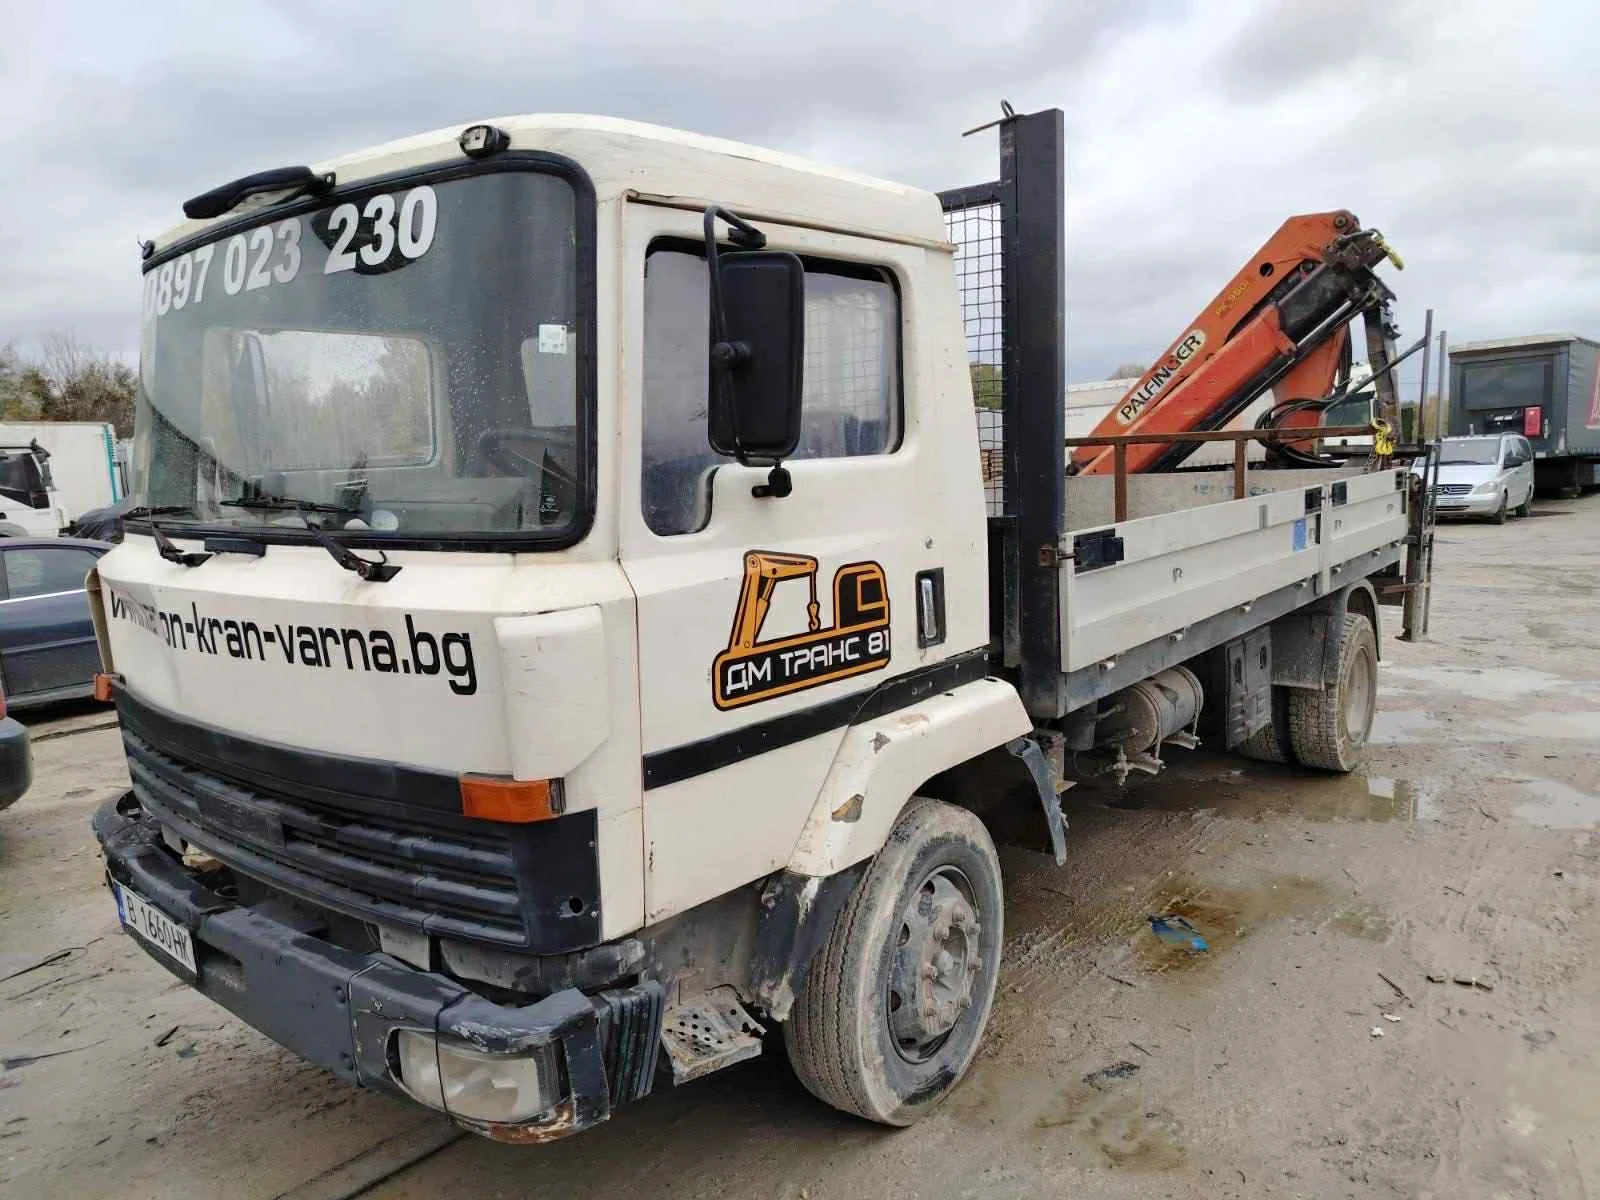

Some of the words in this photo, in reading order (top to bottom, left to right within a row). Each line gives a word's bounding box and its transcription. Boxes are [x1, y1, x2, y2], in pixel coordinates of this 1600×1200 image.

[223, 218, 302, 296] 023
[323, 184, 438, 275] 230
[1120, 335, 1202, 420] PALFINGER
[726, 656, 772, 695] ДМ
[780, 636, 860, 677] ТРАНС
[868, 628, 890, 654] 81
